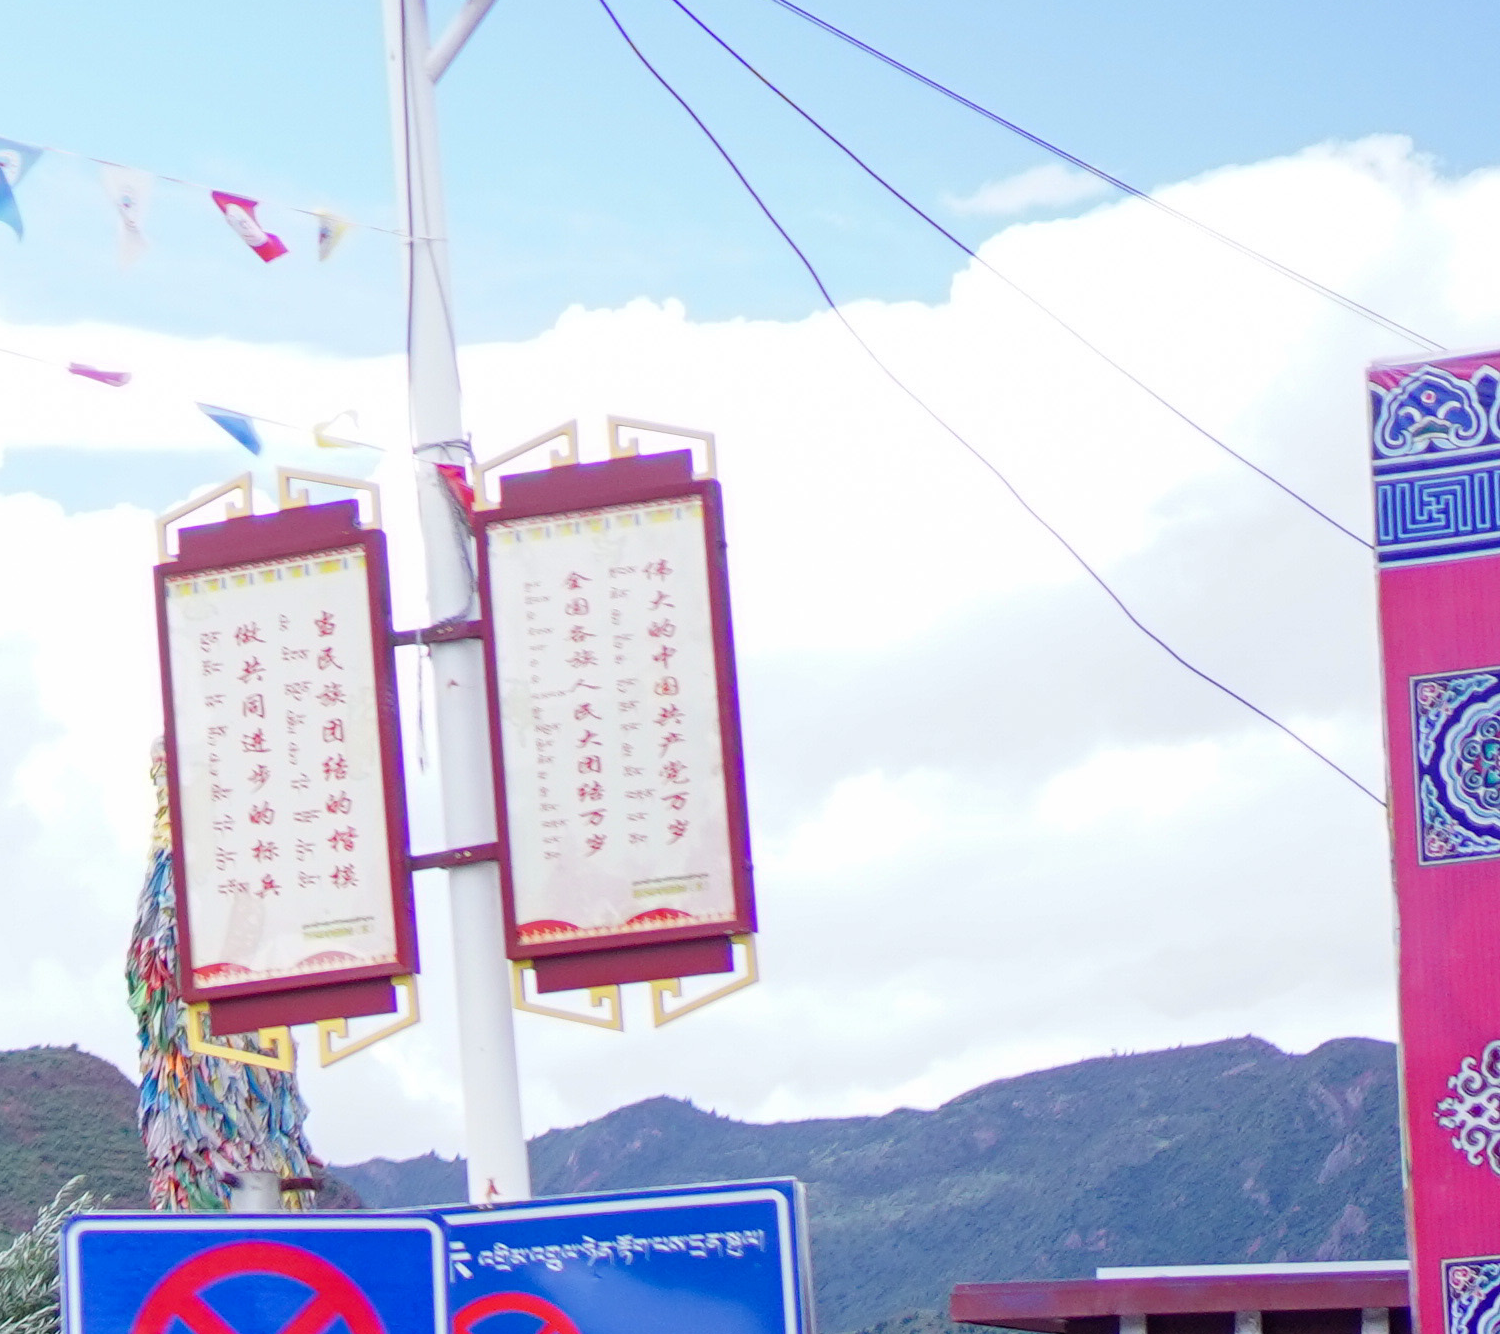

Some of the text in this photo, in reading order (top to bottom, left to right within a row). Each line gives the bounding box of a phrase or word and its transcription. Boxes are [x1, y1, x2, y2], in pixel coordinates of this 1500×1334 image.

[313, 610, 360, 890] 当民族团结的楷模
[564, 570, 608, 858] 全国各族人民大团结万岁
[641, 558, 691, 846] 伟大的中国共产党万岁
